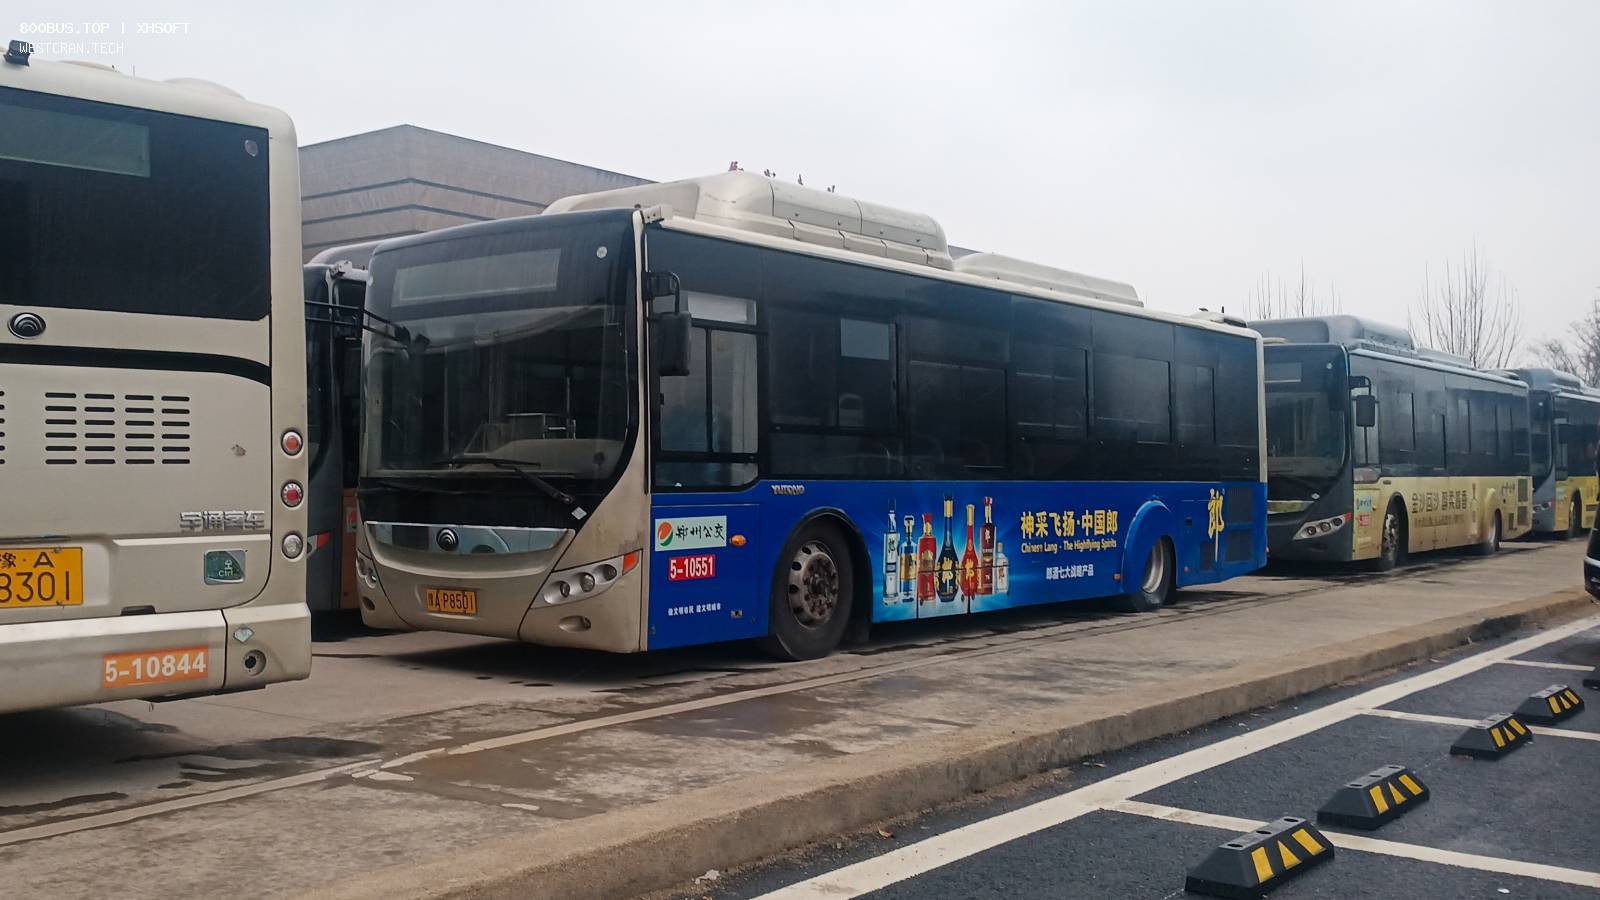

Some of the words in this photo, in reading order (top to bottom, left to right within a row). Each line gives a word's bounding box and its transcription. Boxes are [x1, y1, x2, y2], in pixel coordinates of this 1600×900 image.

[675, 523, 725, 541] 郑州公交
[1020, 509, 1118, 539] 神采飞扬·中国郎
[1044, 541, 1058, 554] Lang
[670, 556, 713, 579] 5-10551
[105, 652, 206, 682] 5-10844
